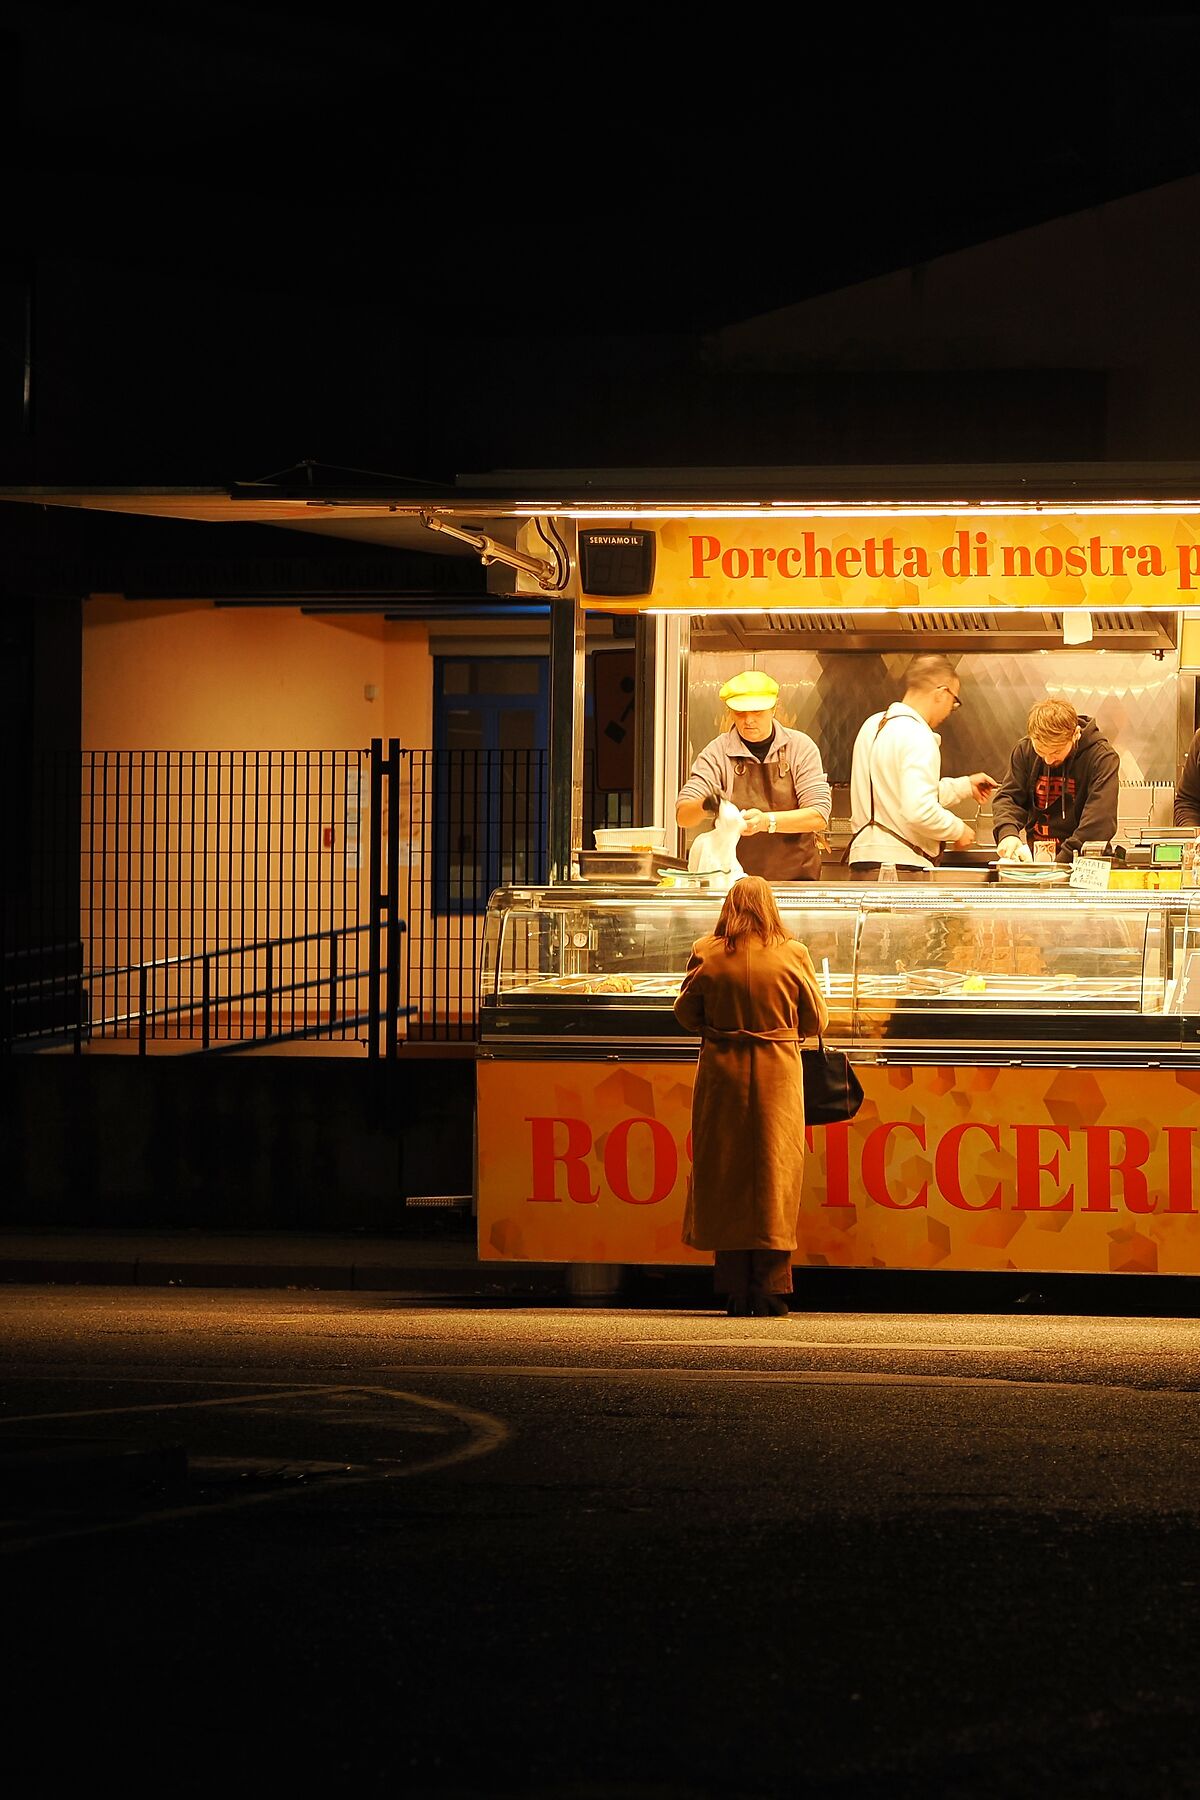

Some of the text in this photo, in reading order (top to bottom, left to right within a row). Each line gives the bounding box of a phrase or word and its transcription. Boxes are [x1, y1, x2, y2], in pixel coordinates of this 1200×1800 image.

[589, 536, 639, 545] SERVIAMO IL
[689, 531, 931, 579] Porchetta
[943, 530, 990, 577] di
[1001, 536, 1166, 578] nostra
